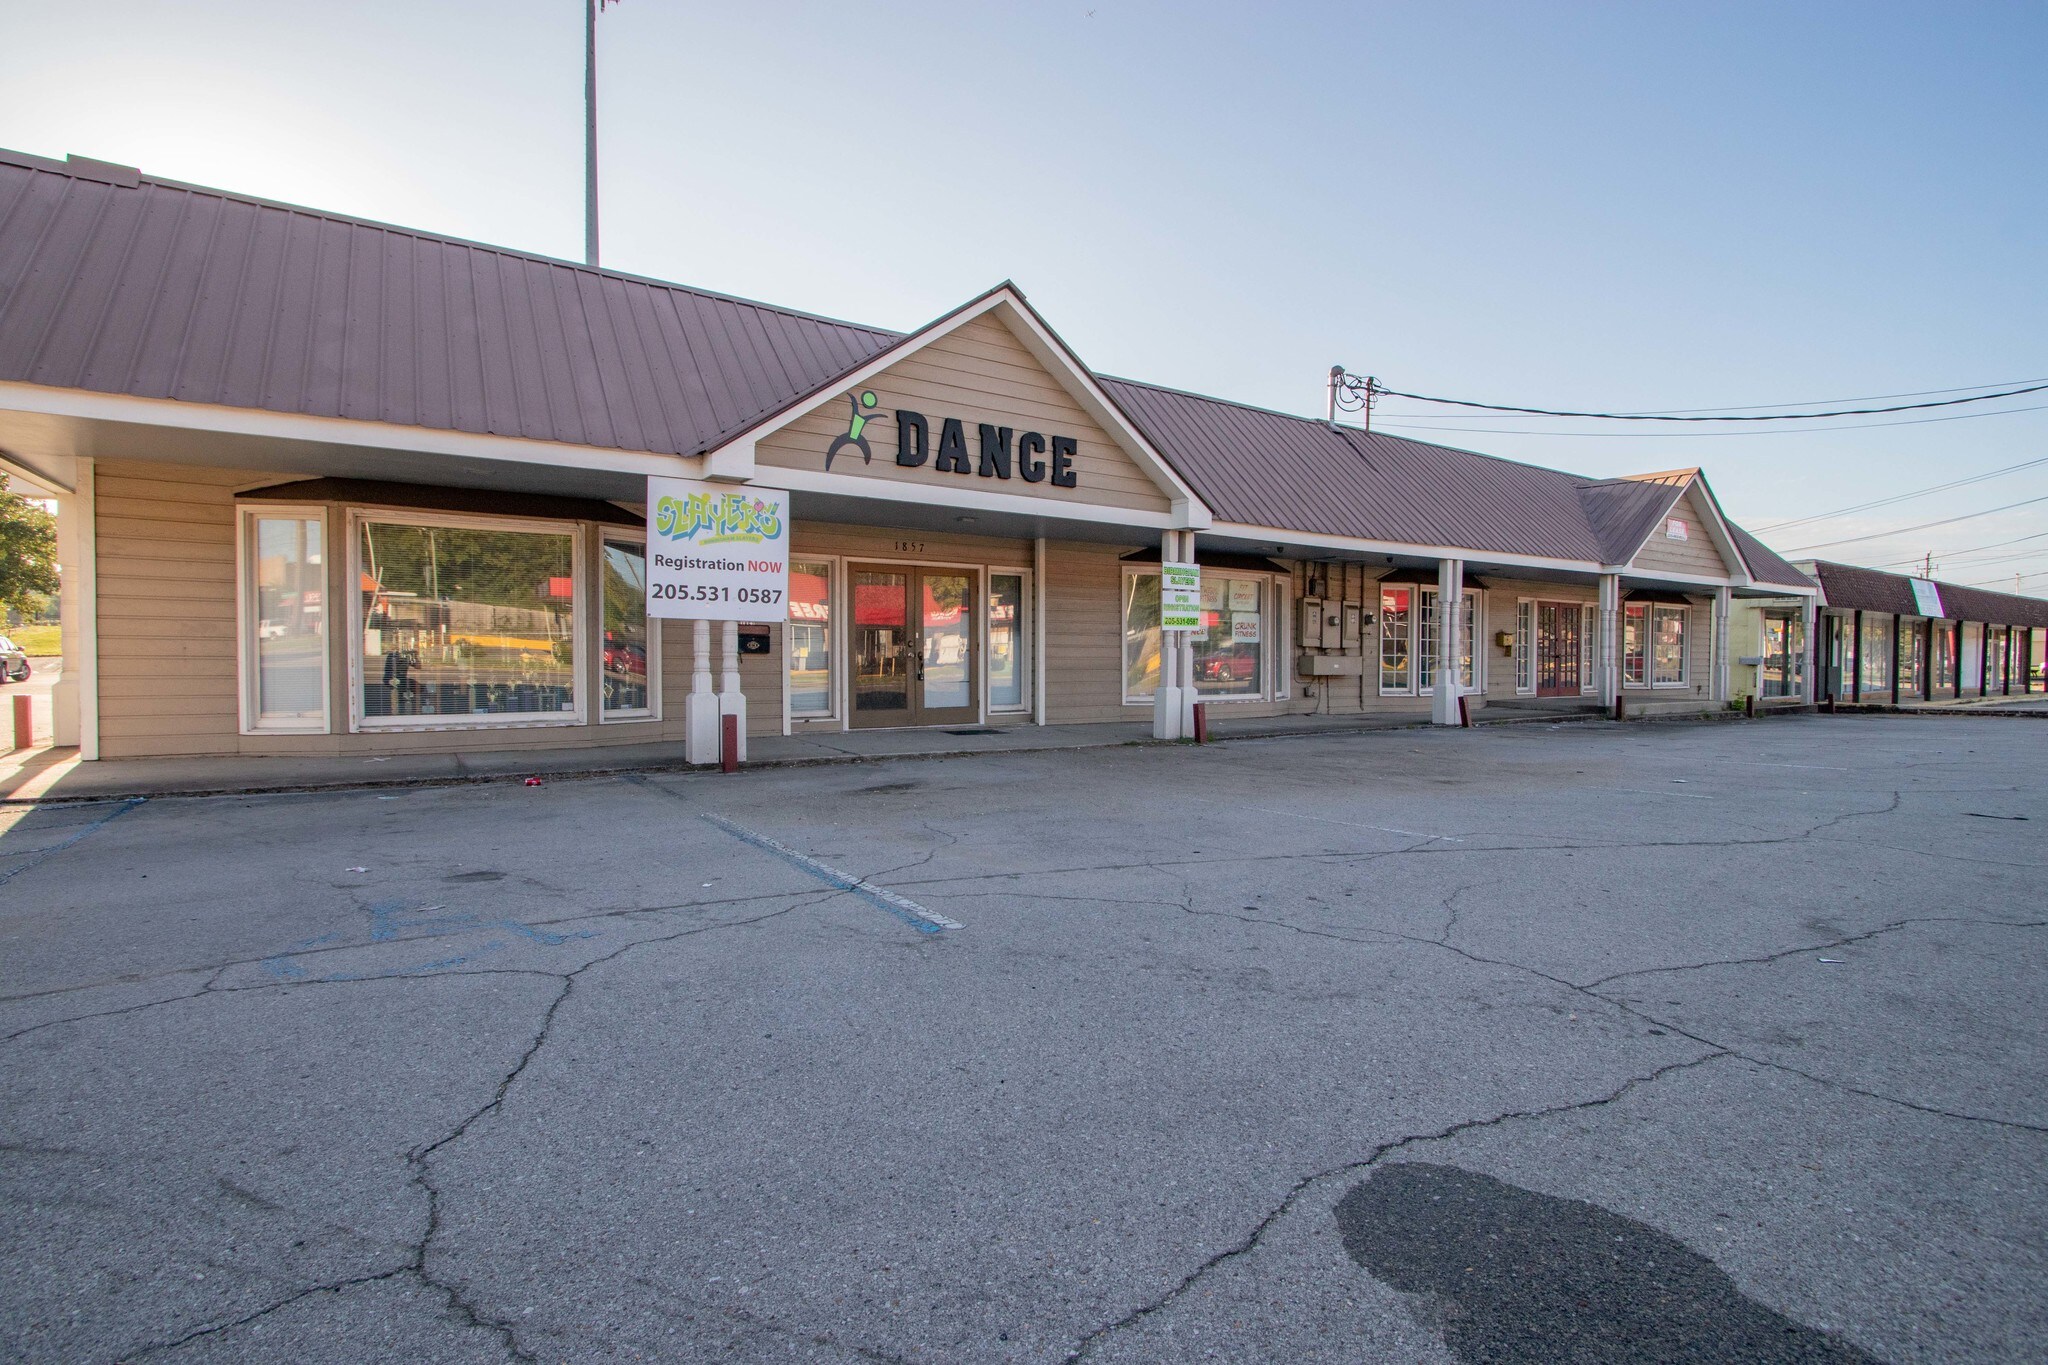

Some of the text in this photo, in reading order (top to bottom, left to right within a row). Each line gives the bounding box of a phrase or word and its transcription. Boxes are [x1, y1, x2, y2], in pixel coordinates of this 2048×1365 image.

[896, 409, 1077, 488] DANCE
[895, 541, 924, 552] 1857
[655, 554, 782, 573] Registration NOW
[1170, 575, 1195, 586] SLAYERS
[652, 583, 782, 604] 205.531 0587
[1164, 617, 1199, 625] 205-531-0587
[1234, 622, 1257, 630] CRUNK
[1234, 630, 1257, 638] FITNESS
